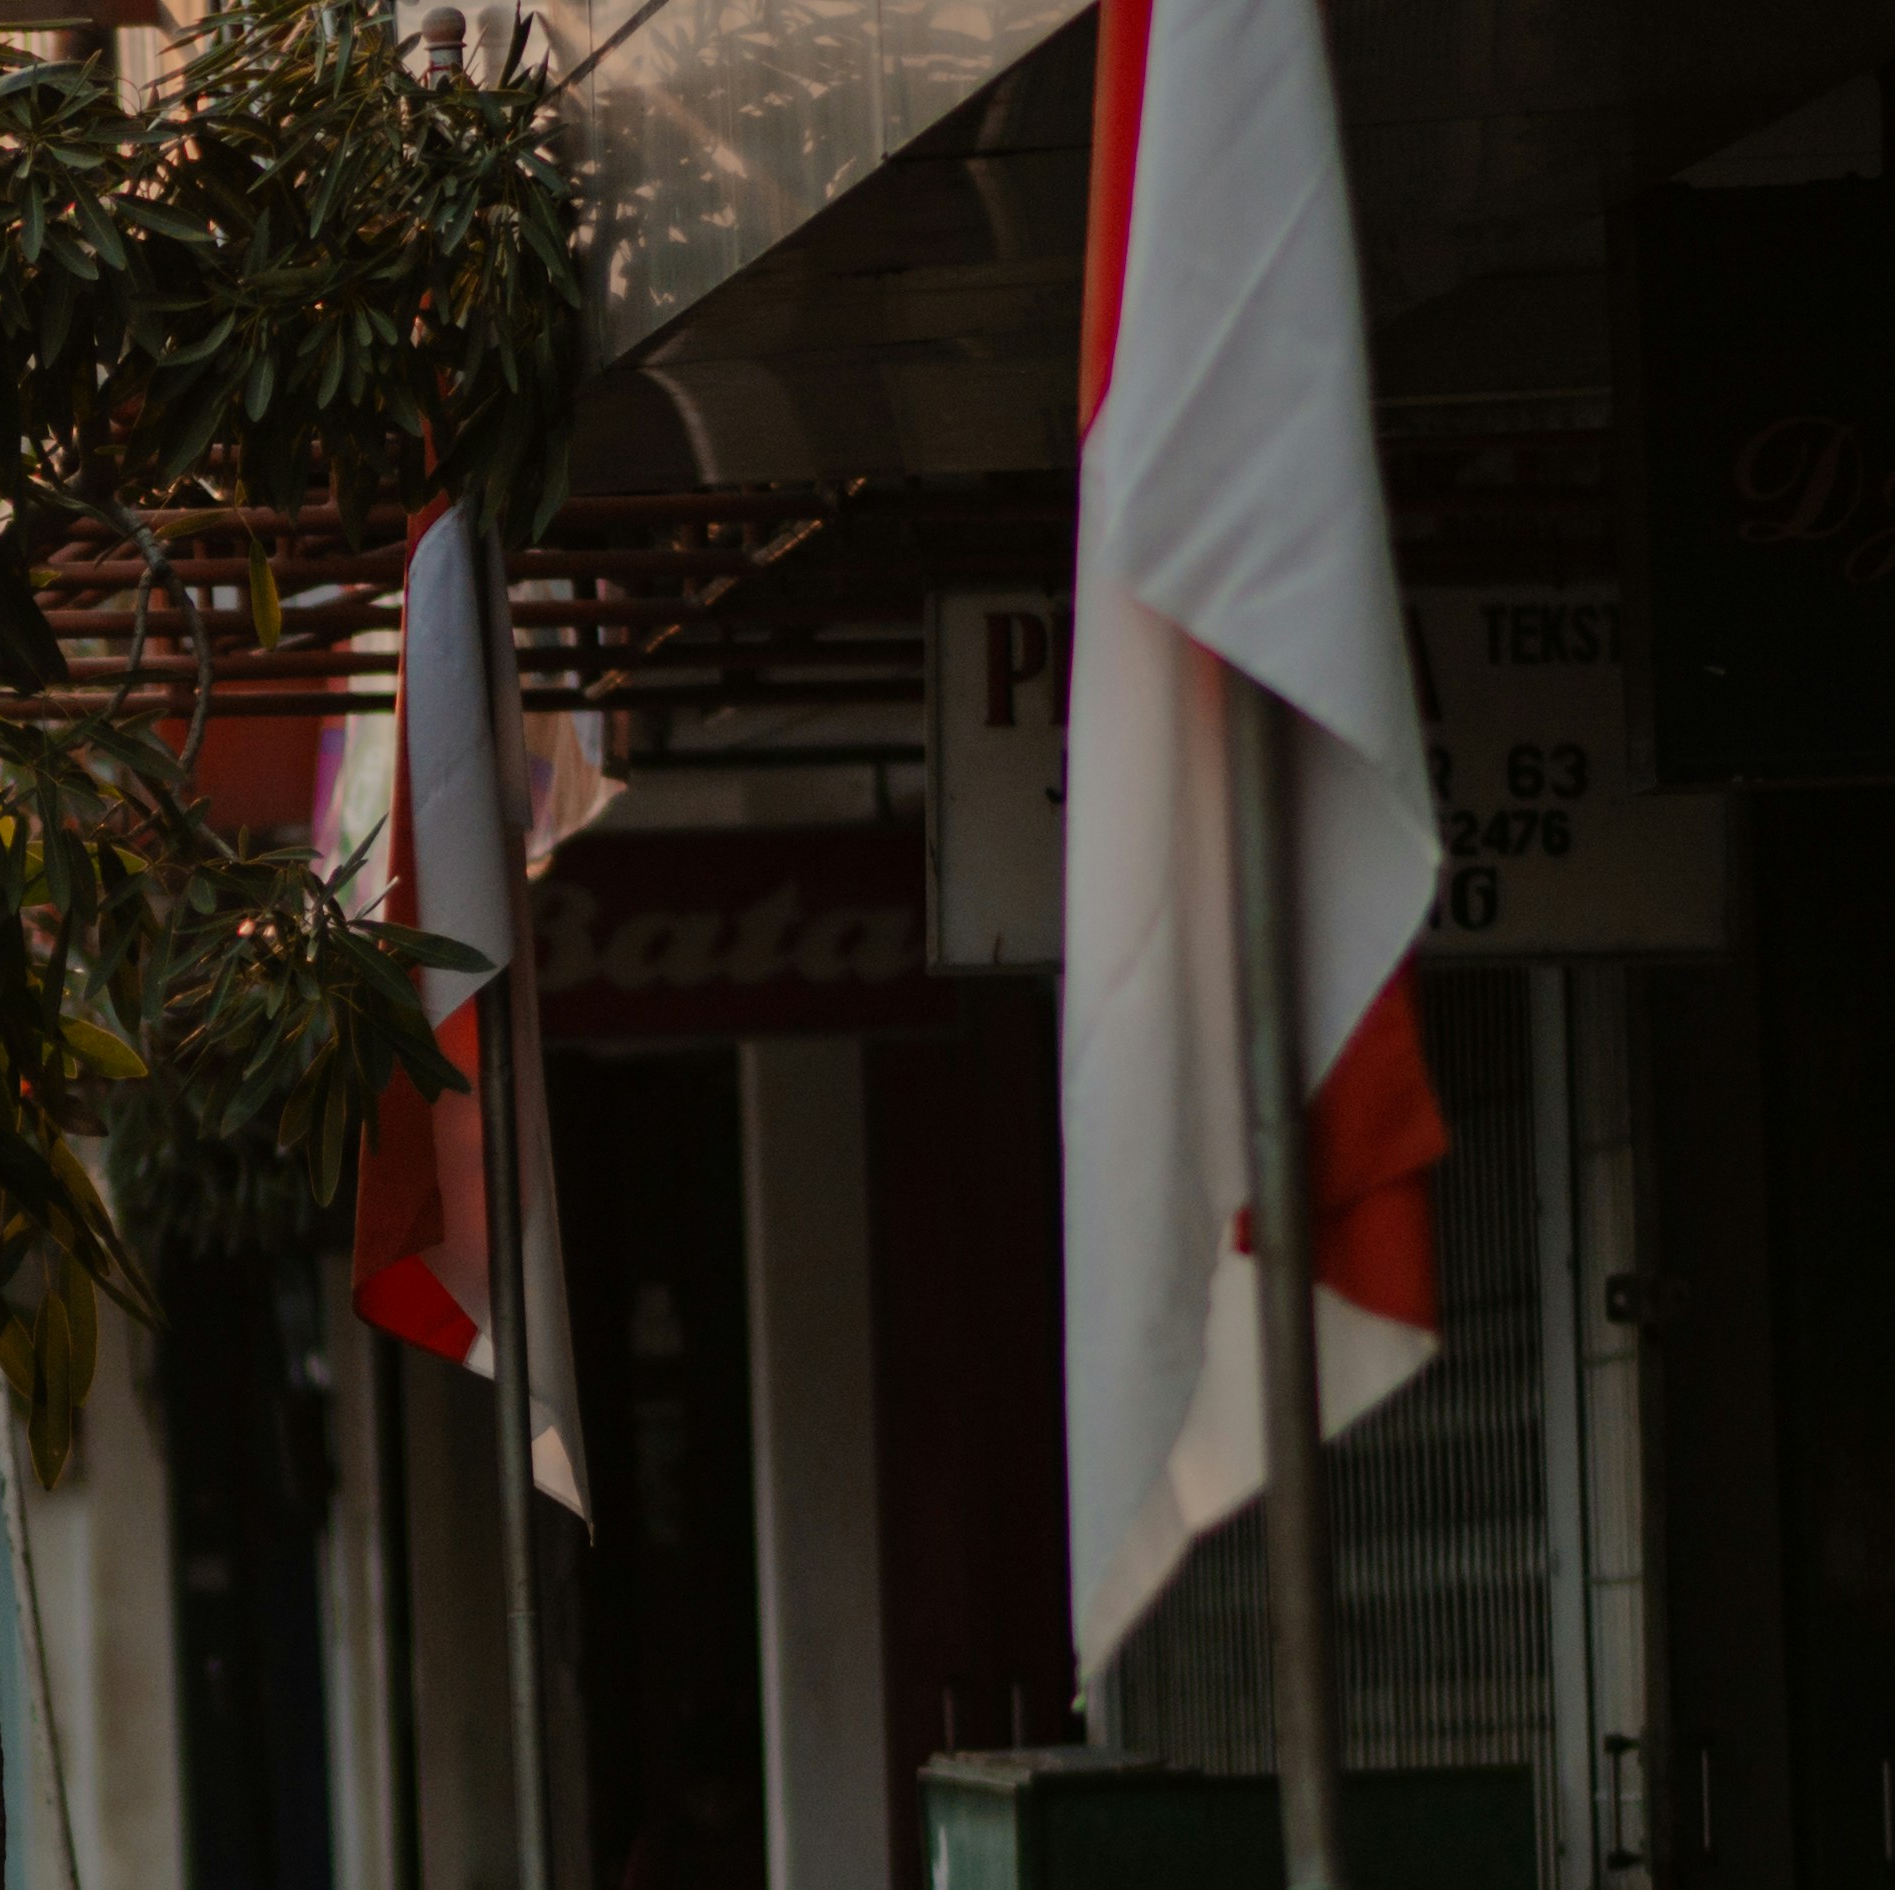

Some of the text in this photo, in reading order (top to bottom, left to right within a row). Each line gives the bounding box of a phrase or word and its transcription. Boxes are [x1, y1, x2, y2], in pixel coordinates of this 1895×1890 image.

[1508, 743, 1588, 799] 63
[1441, 808, 1571, 856] 2476
[531, 878, 923, 994] Bata
